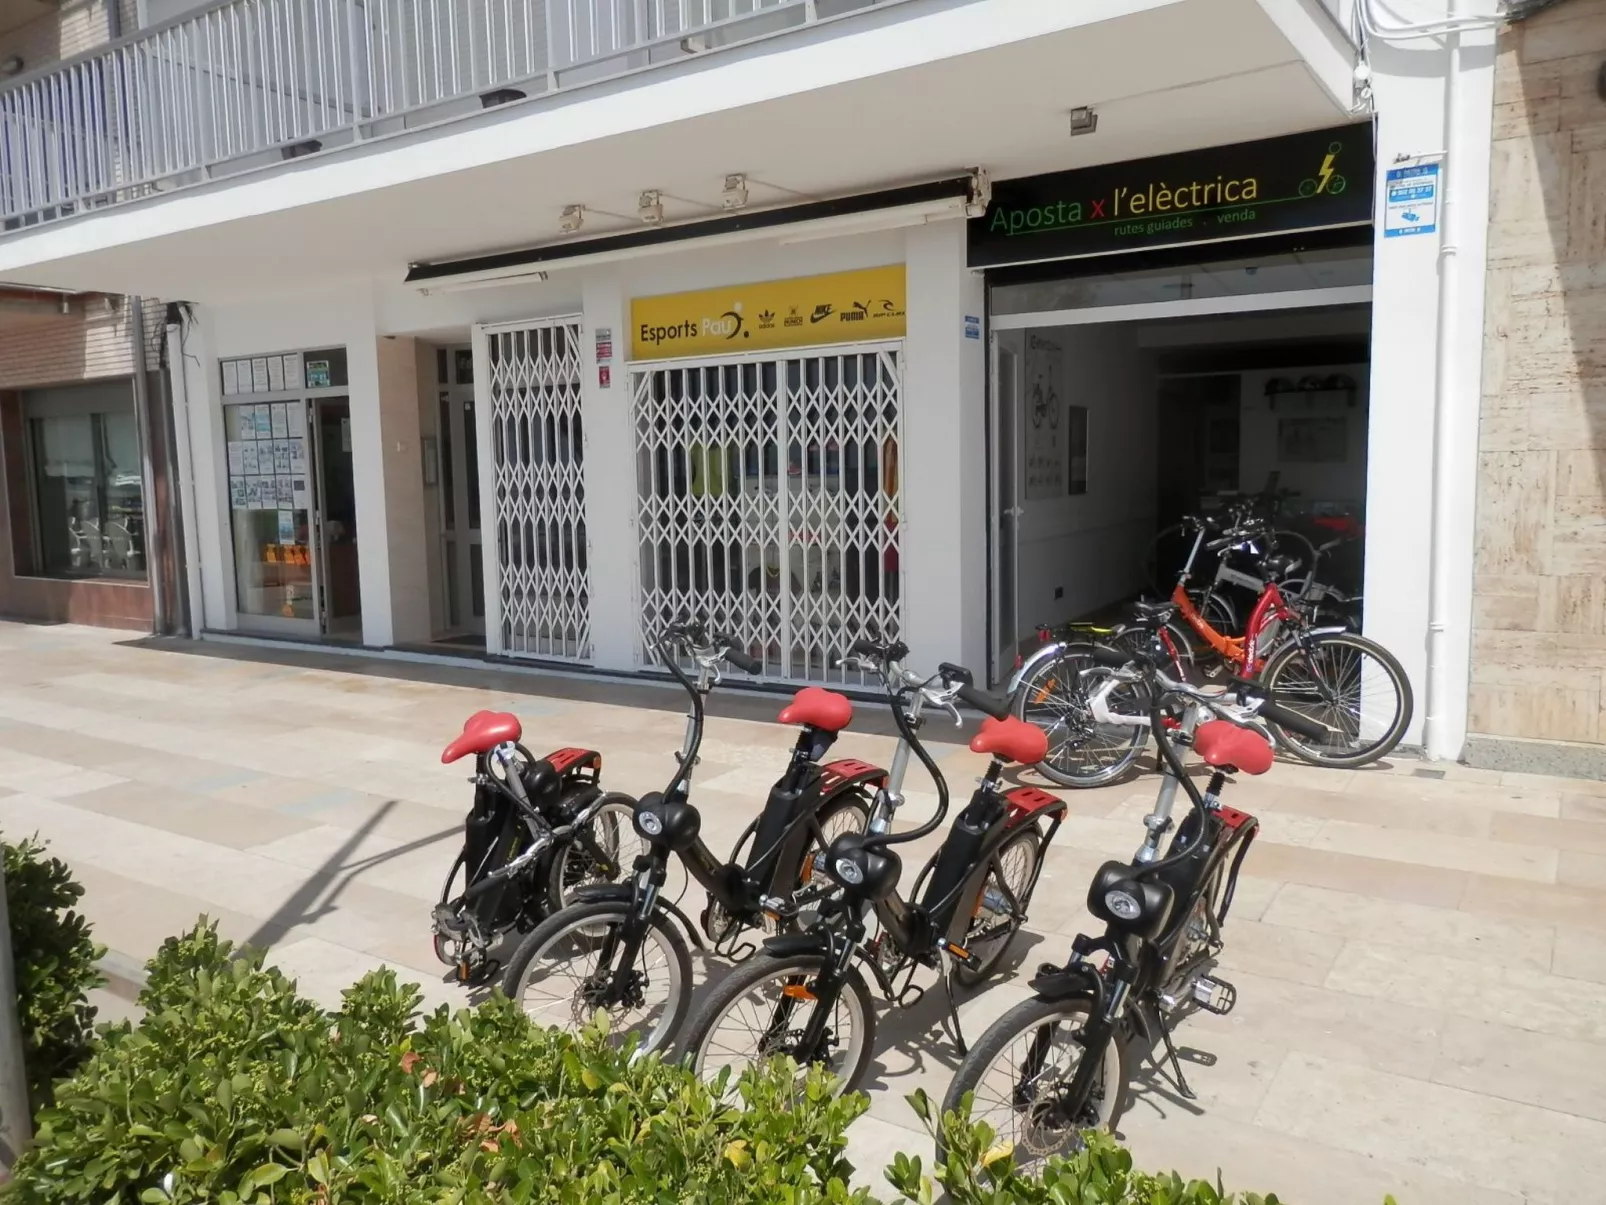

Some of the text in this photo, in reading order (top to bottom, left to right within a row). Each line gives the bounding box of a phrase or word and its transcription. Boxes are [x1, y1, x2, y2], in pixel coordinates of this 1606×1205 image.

[990, 200, 1083, 236] Aposta
[1090, 199, 1105, 219] x
[1113, 208, 1256, 237] rutes guiades venda
[840, 311, 864, 322] PUMA
[640, 318, 732, 345] Esports Pau
